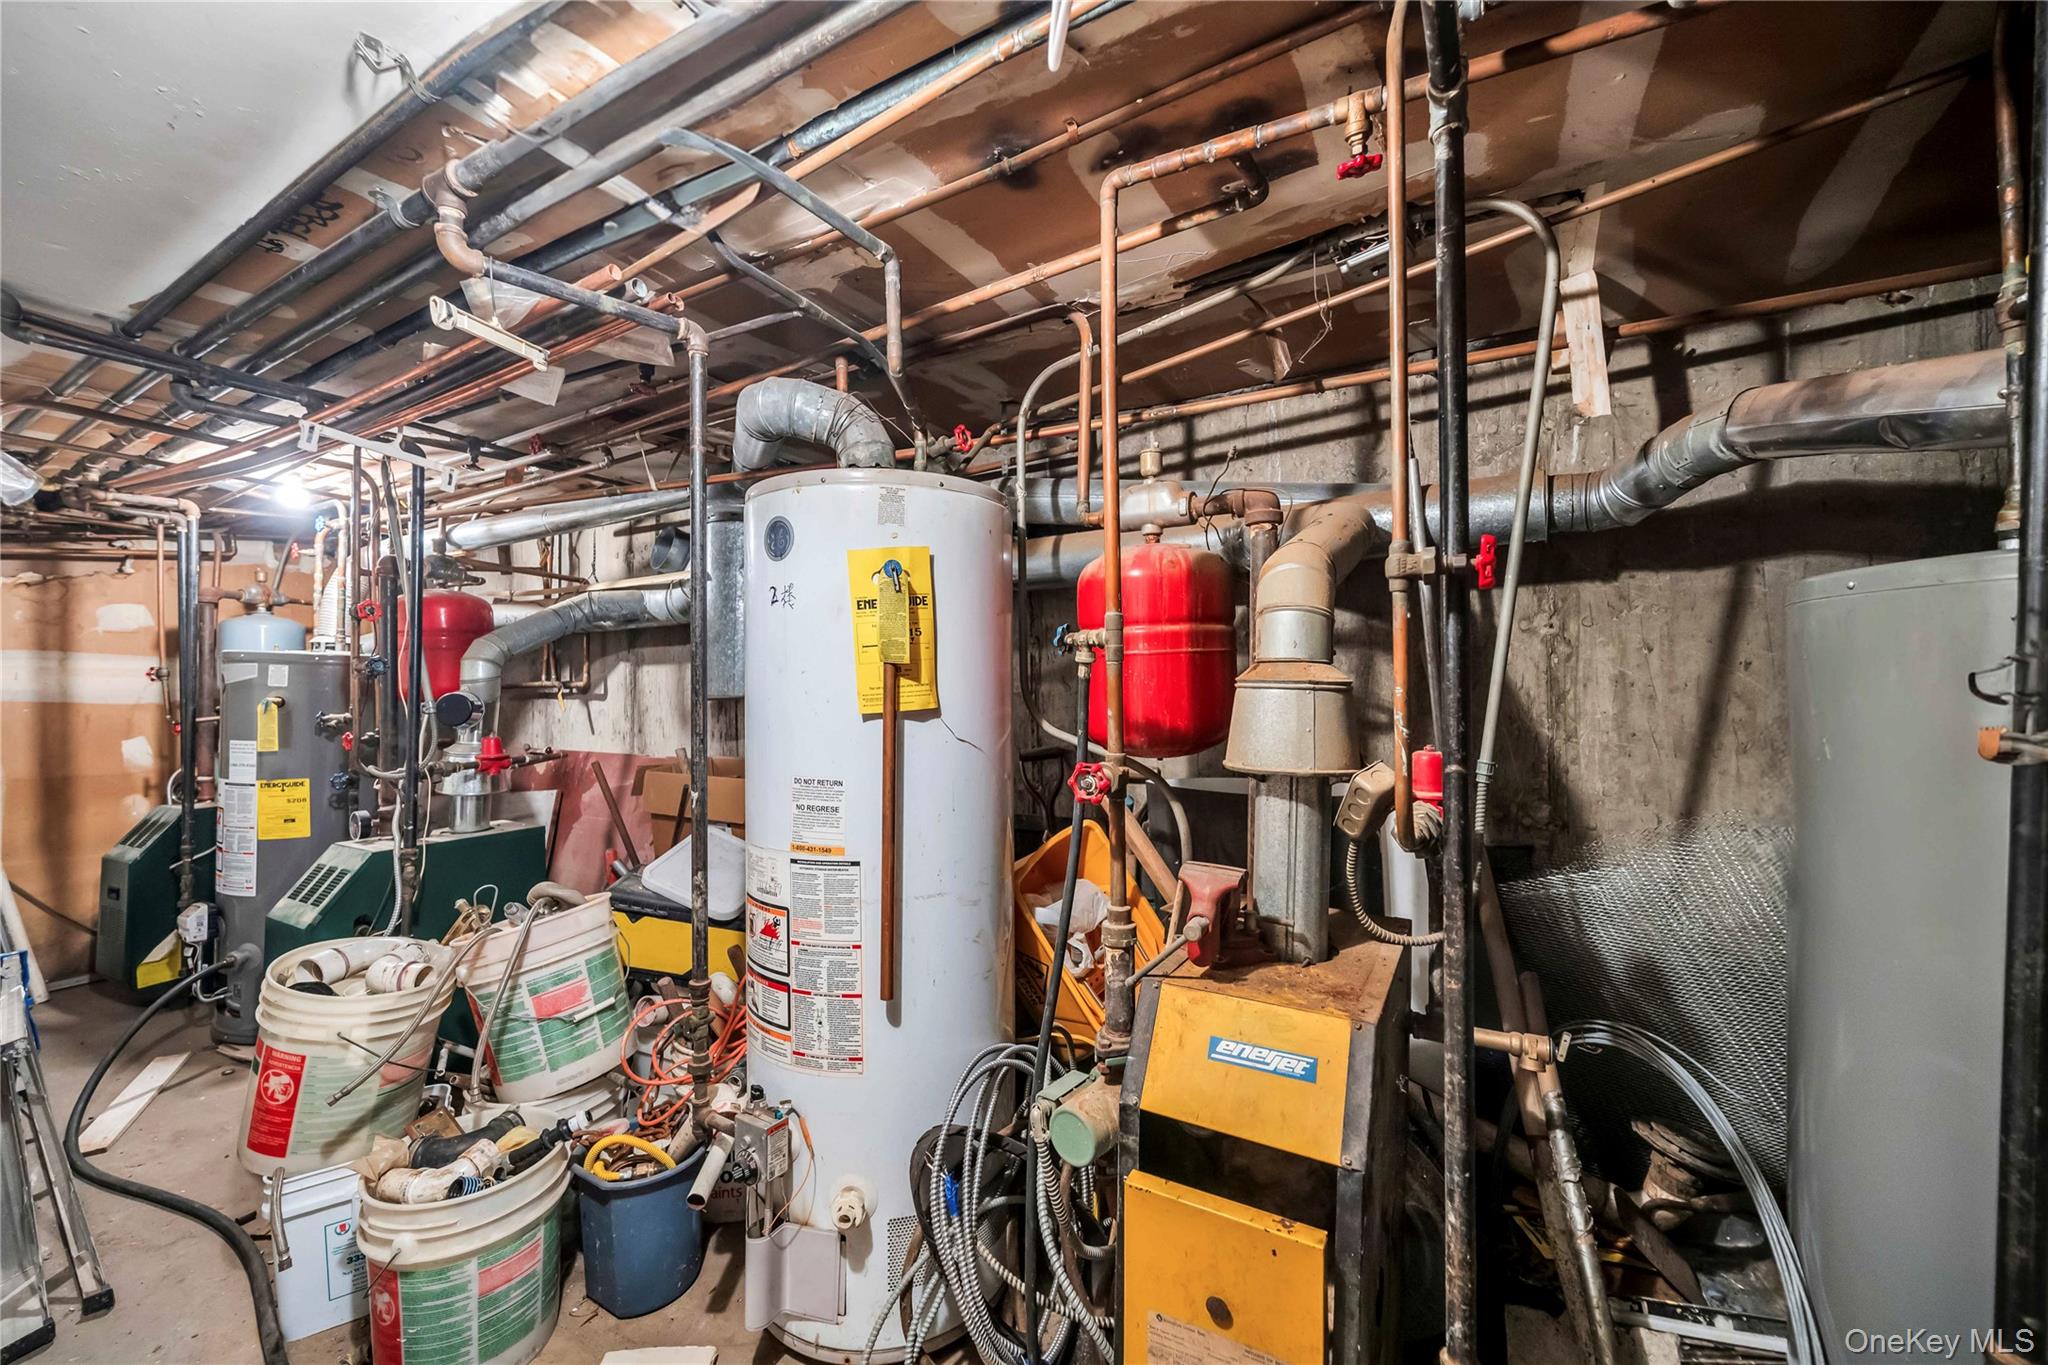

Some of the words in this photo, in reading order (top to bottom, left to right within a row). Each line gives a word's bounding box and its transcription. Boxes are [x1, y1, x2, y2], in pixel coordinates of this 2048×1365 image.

[794, 777, 803, 785] DO
[803, 778, 816, 786] NOT
[817, 779, 844, 787] RETURN
[795, 803, 806, 811] NO
[806, 804, 840, 813] REGRESE
[271, 1049, 303, 1063] WARNING
[1212, 1039, 1314, 1075] enerjet
[711, 1187, 743, 1200] aints
